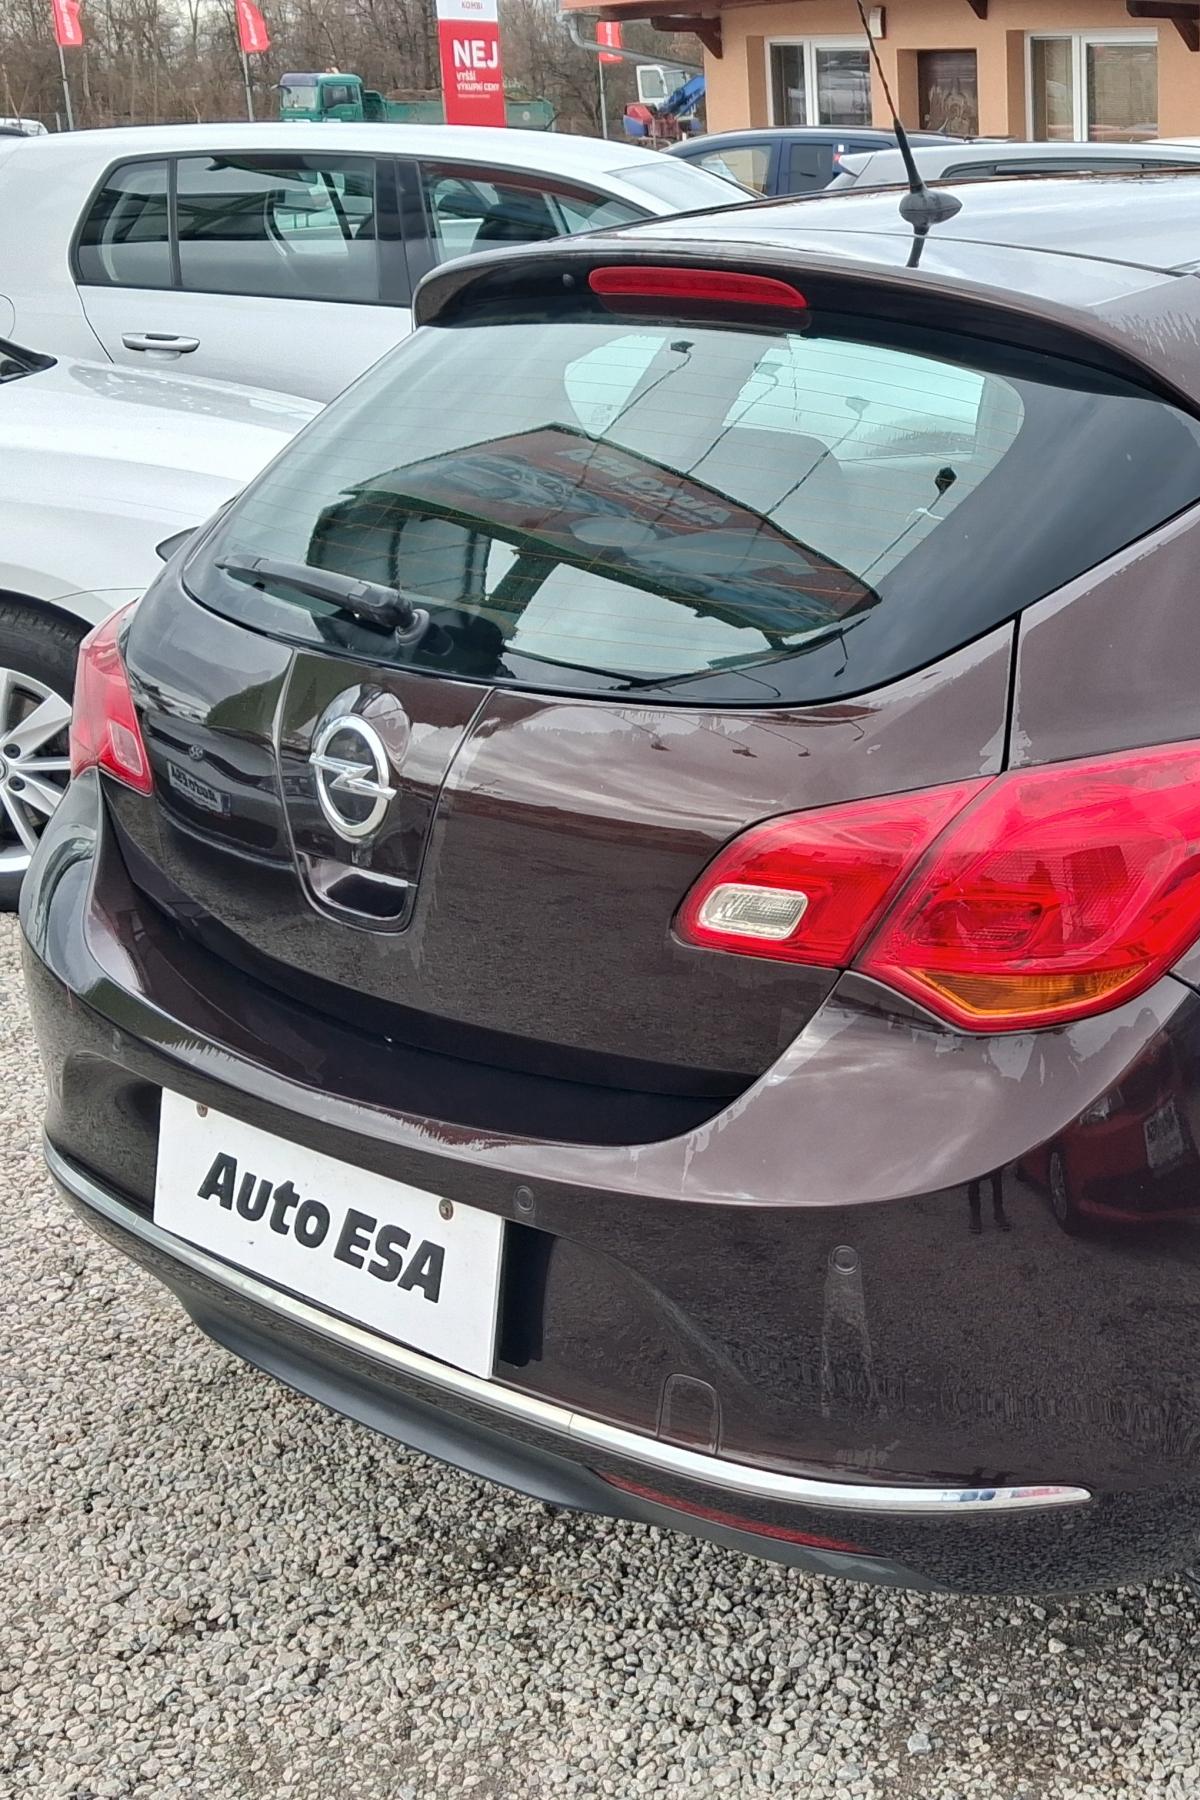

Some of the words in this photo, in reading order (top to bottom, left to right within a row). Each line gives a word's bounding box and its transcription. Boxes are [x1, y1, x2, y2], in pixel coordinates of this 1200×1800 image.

[453, 39, 498, 69] NEJ
[197, 1151, 331, 1249] Auto
[333, 1207, 446, 1304] ESA
